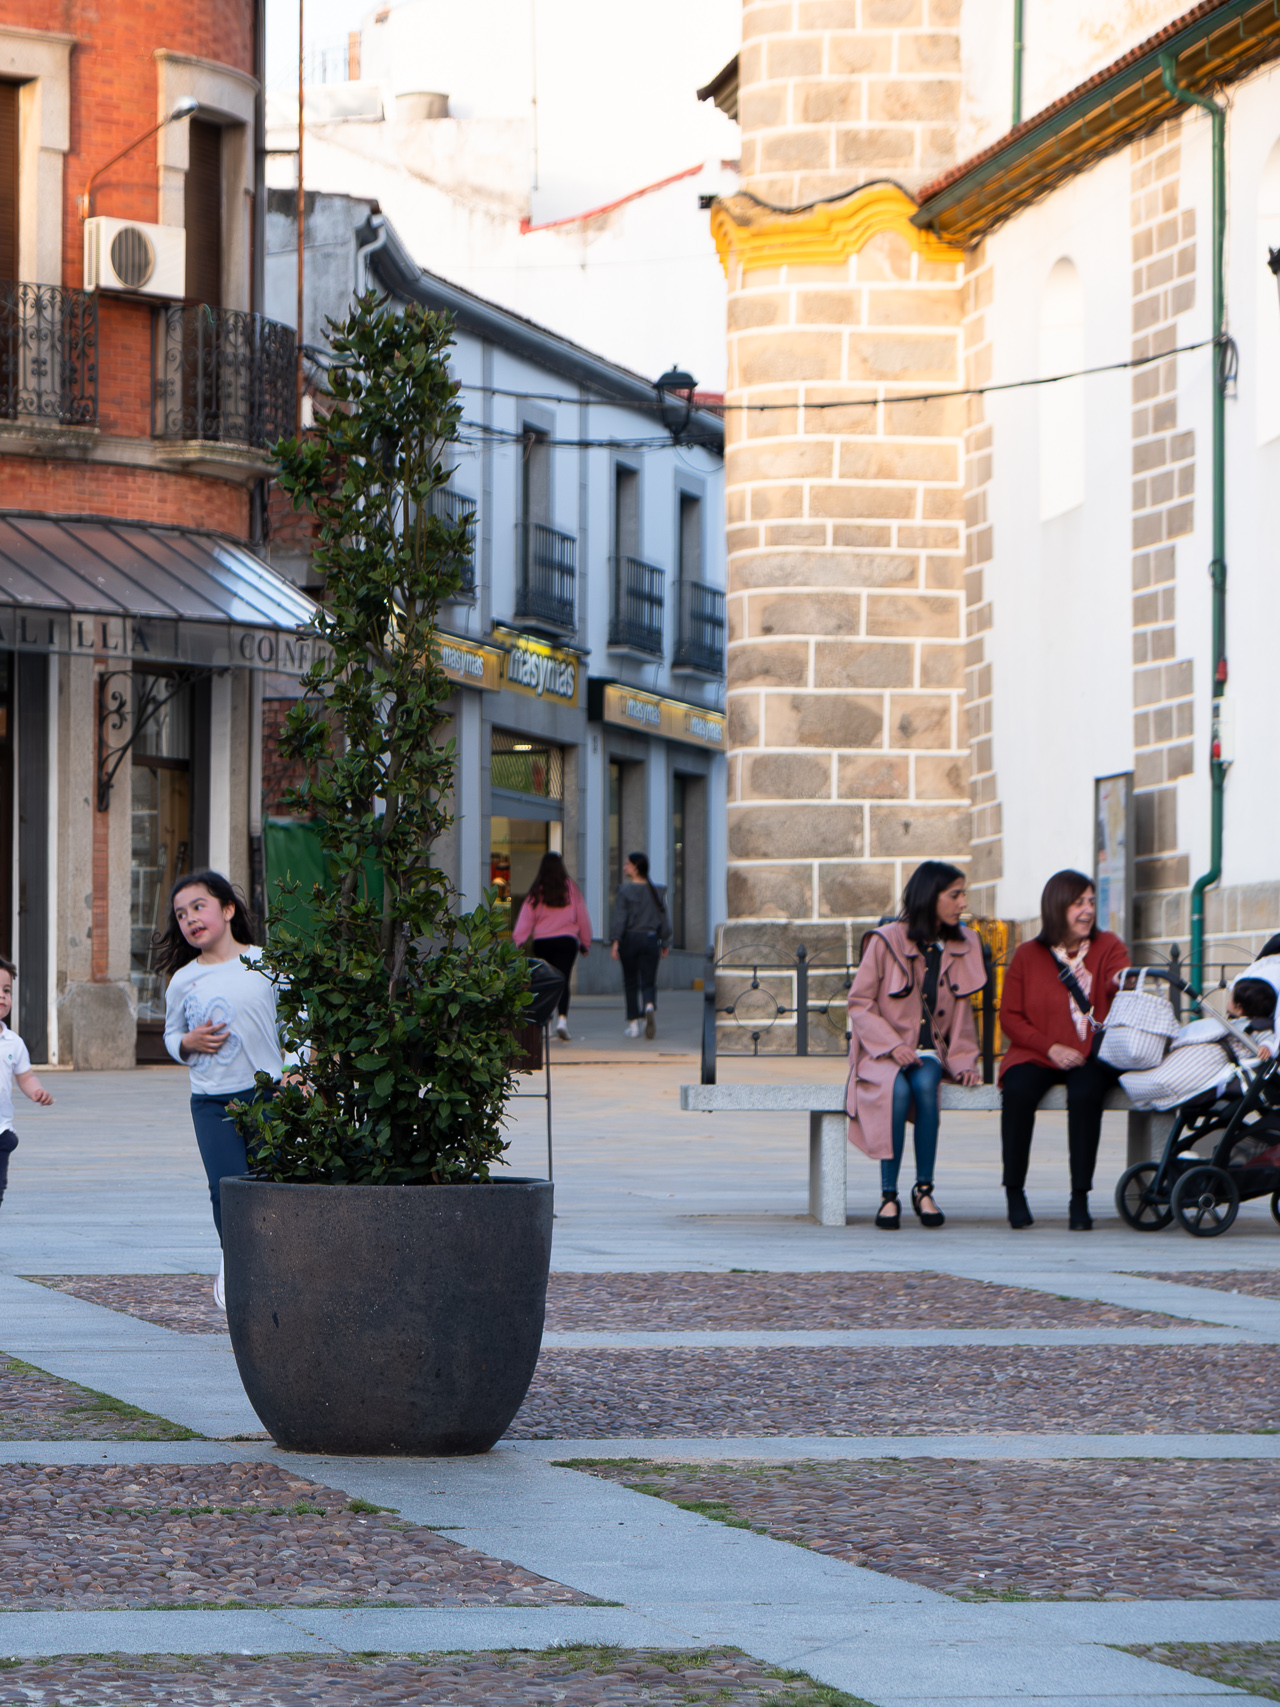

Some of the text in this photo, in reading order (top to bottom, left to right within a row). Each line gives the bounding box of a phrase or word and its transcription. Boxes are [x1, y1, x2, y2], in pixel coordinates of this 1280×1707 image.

[441, 644, 484, 678] masymas
[507, 648, 576, 699] masymas
[627, 697, 661, 725] masymas
